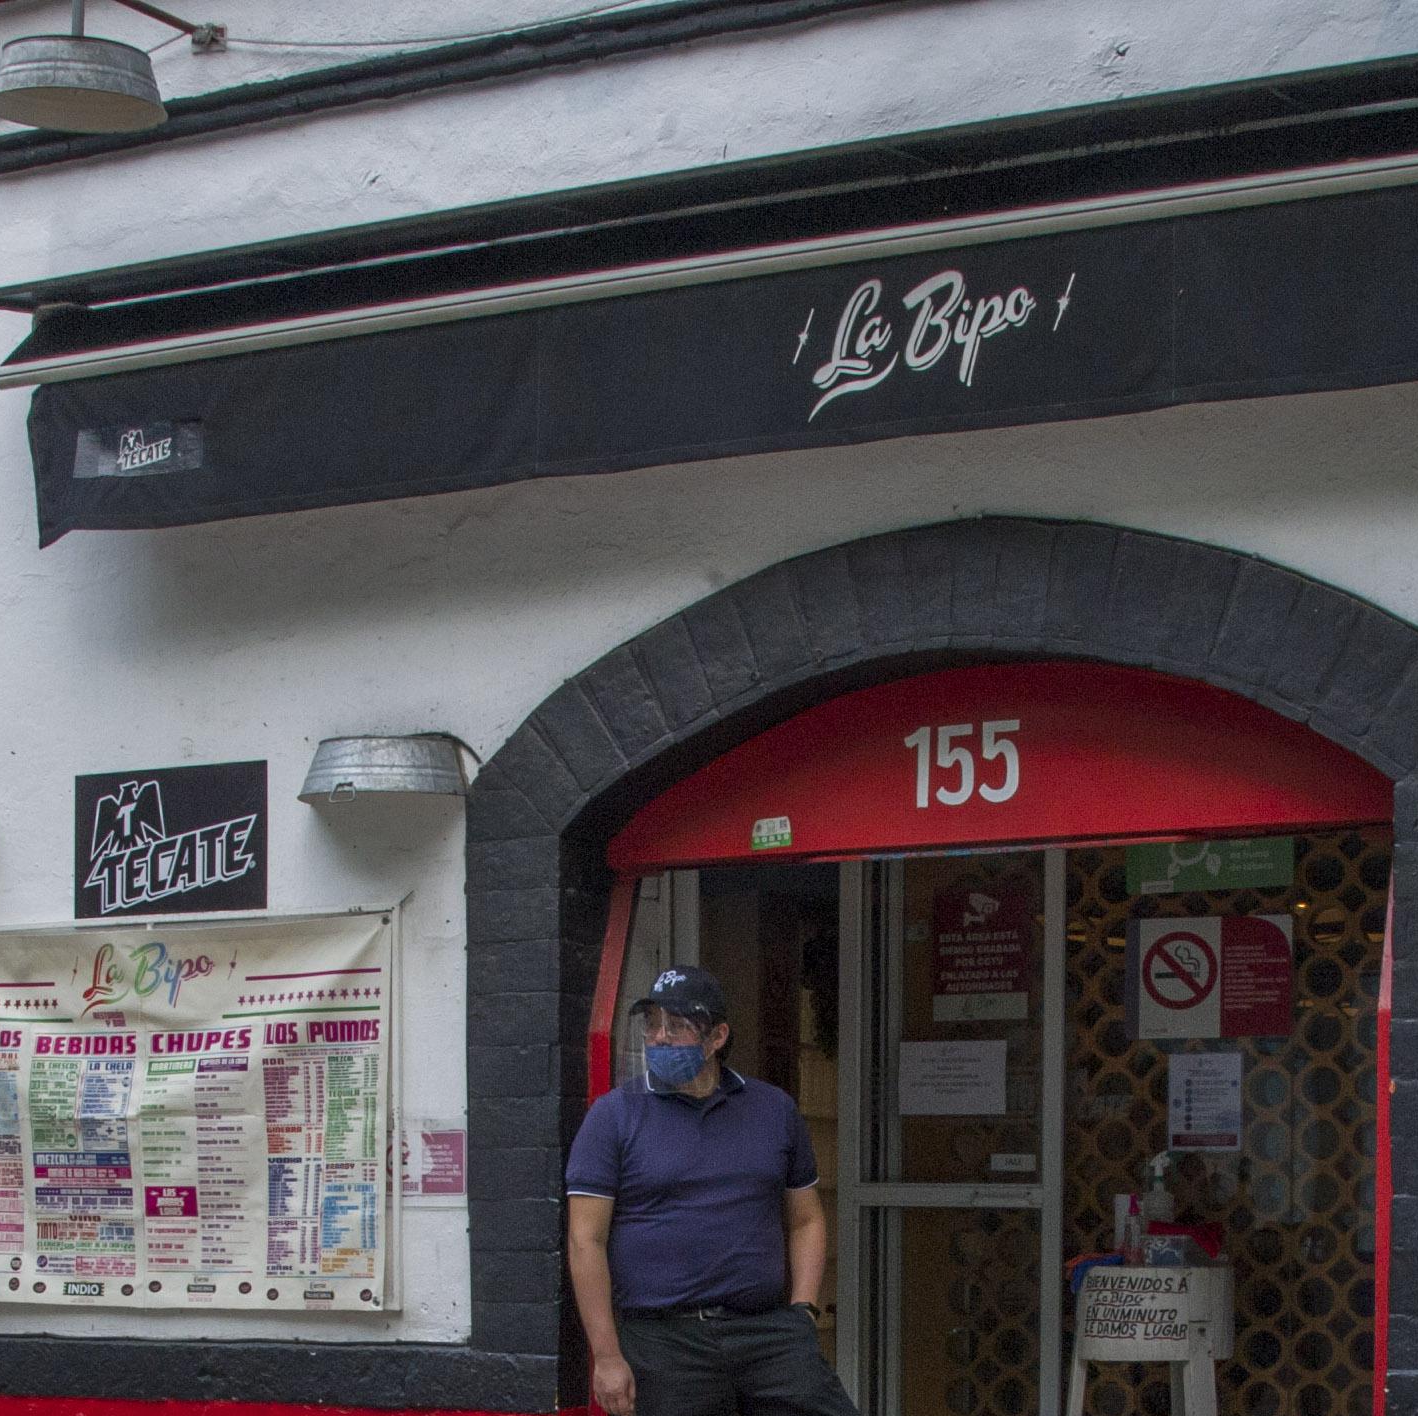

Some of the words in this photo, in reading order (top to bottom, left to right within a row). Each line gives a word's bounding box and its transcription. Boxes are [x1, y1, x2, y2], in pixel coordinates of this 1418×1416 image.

[812, 278, 895, 395] La
[902, 268, 1036, 387] Bipo
[116, 437, 173, 471] TECATE
[904, 717, 1022, 810] 155
[83, 813, 258, 915] TECATE
[82, 943, 125, 1001] La
[128, 942, 215, 1008] Bipo
[35, 1035, 137, 1055] BEBIDAS
[150, 1028, 252, 1054] CHUPES
[263, 1021, 299, 1046] LOS
[306, 1018, 381, 1044] POMOS
[88, 1062, 101, 1071] LA
[105, 1061, 133, 1071] CHELA
[36, 1154, 71, 1166] MEZCAL
[67, 1284, 100, 1296] INDIO
[1086, 1306, 1099, 1320] EN
[1097, 1321, 1138, 1336] DAMOS
[1143, 1324, 1189, 1338] LUGAR
